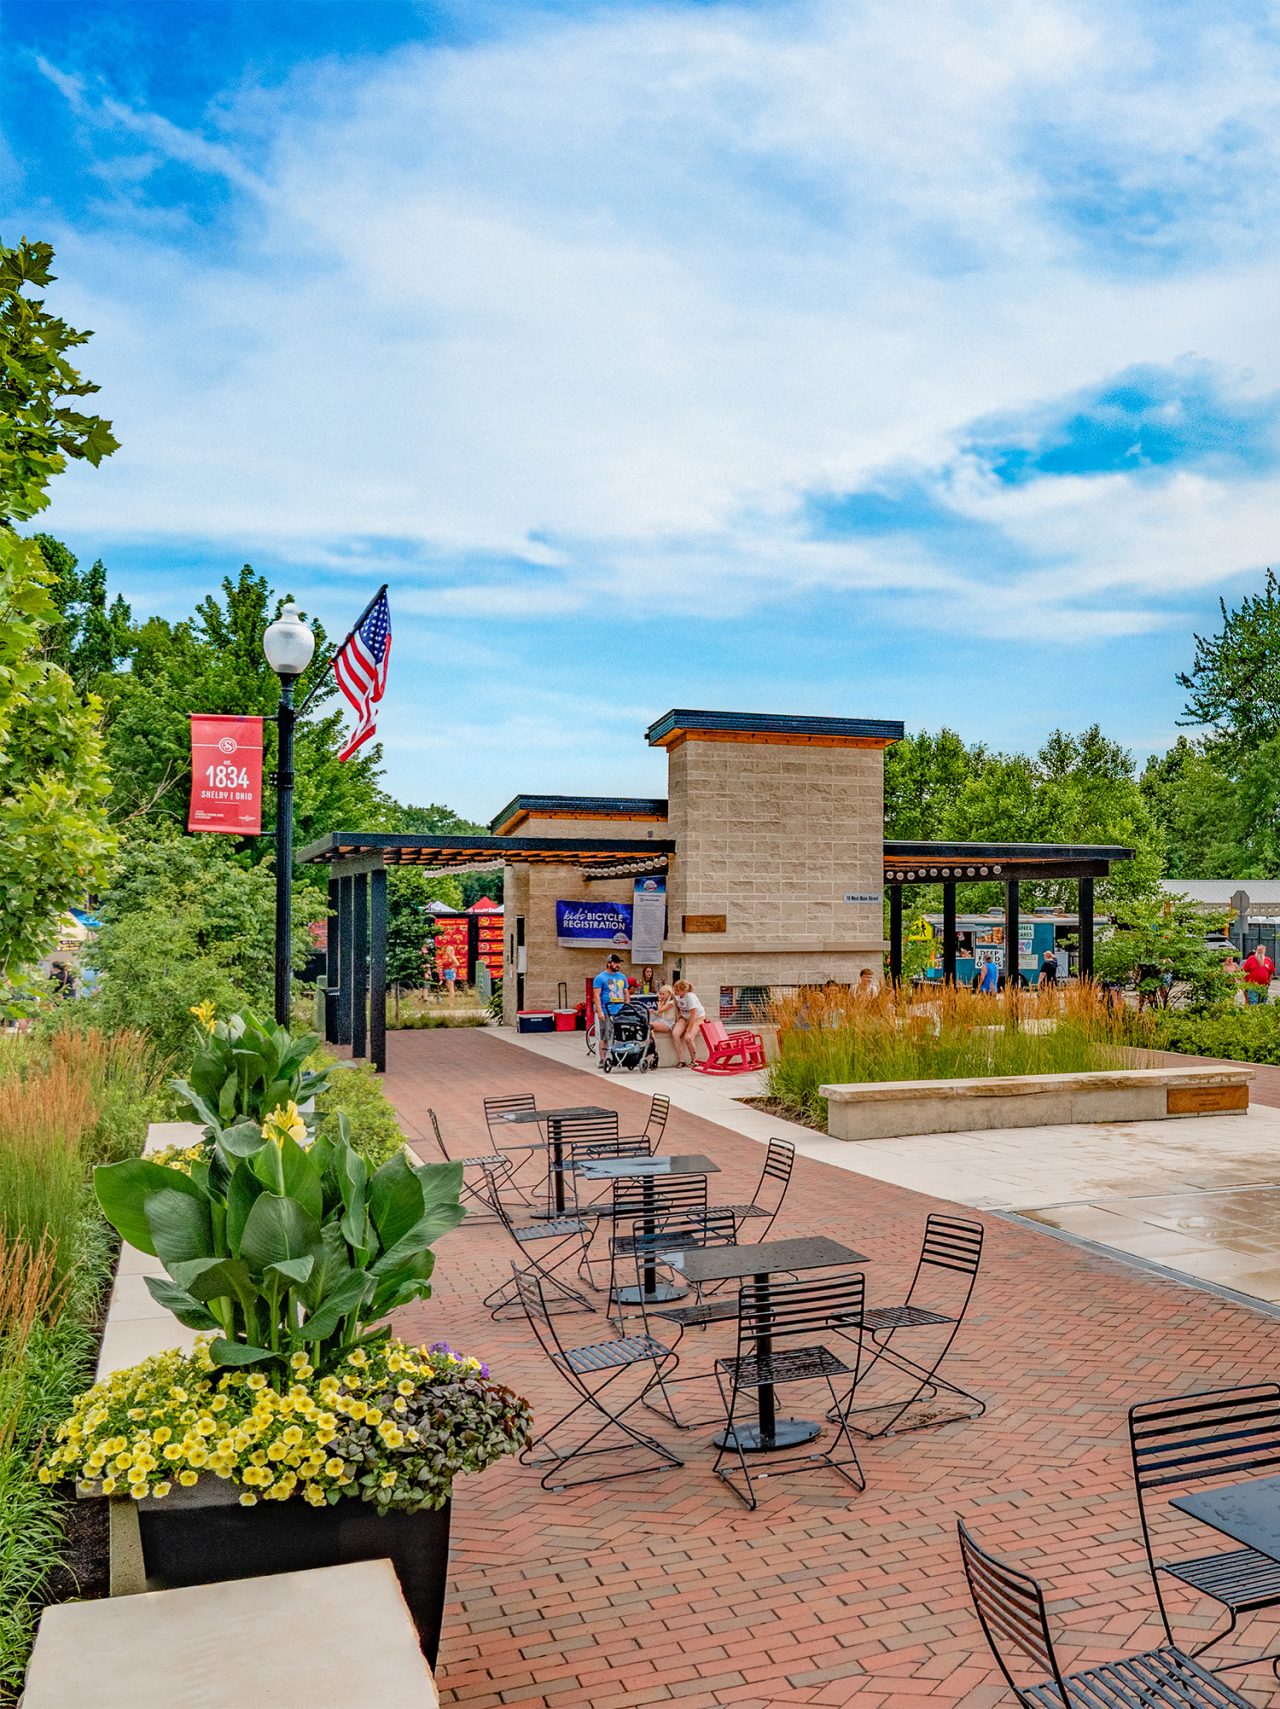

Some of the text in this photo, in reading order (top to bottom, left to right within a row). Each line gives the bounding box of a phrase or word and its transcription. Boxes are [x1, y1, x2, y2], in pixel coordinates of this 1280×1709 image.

[206, 765, 250, 789] 1834
[201, 790, 253, 801] SHELBY OHIO
[563, 908, 624, 922] kids' BICYCLE
[563, 920, 626, 930] REGISTRATION
